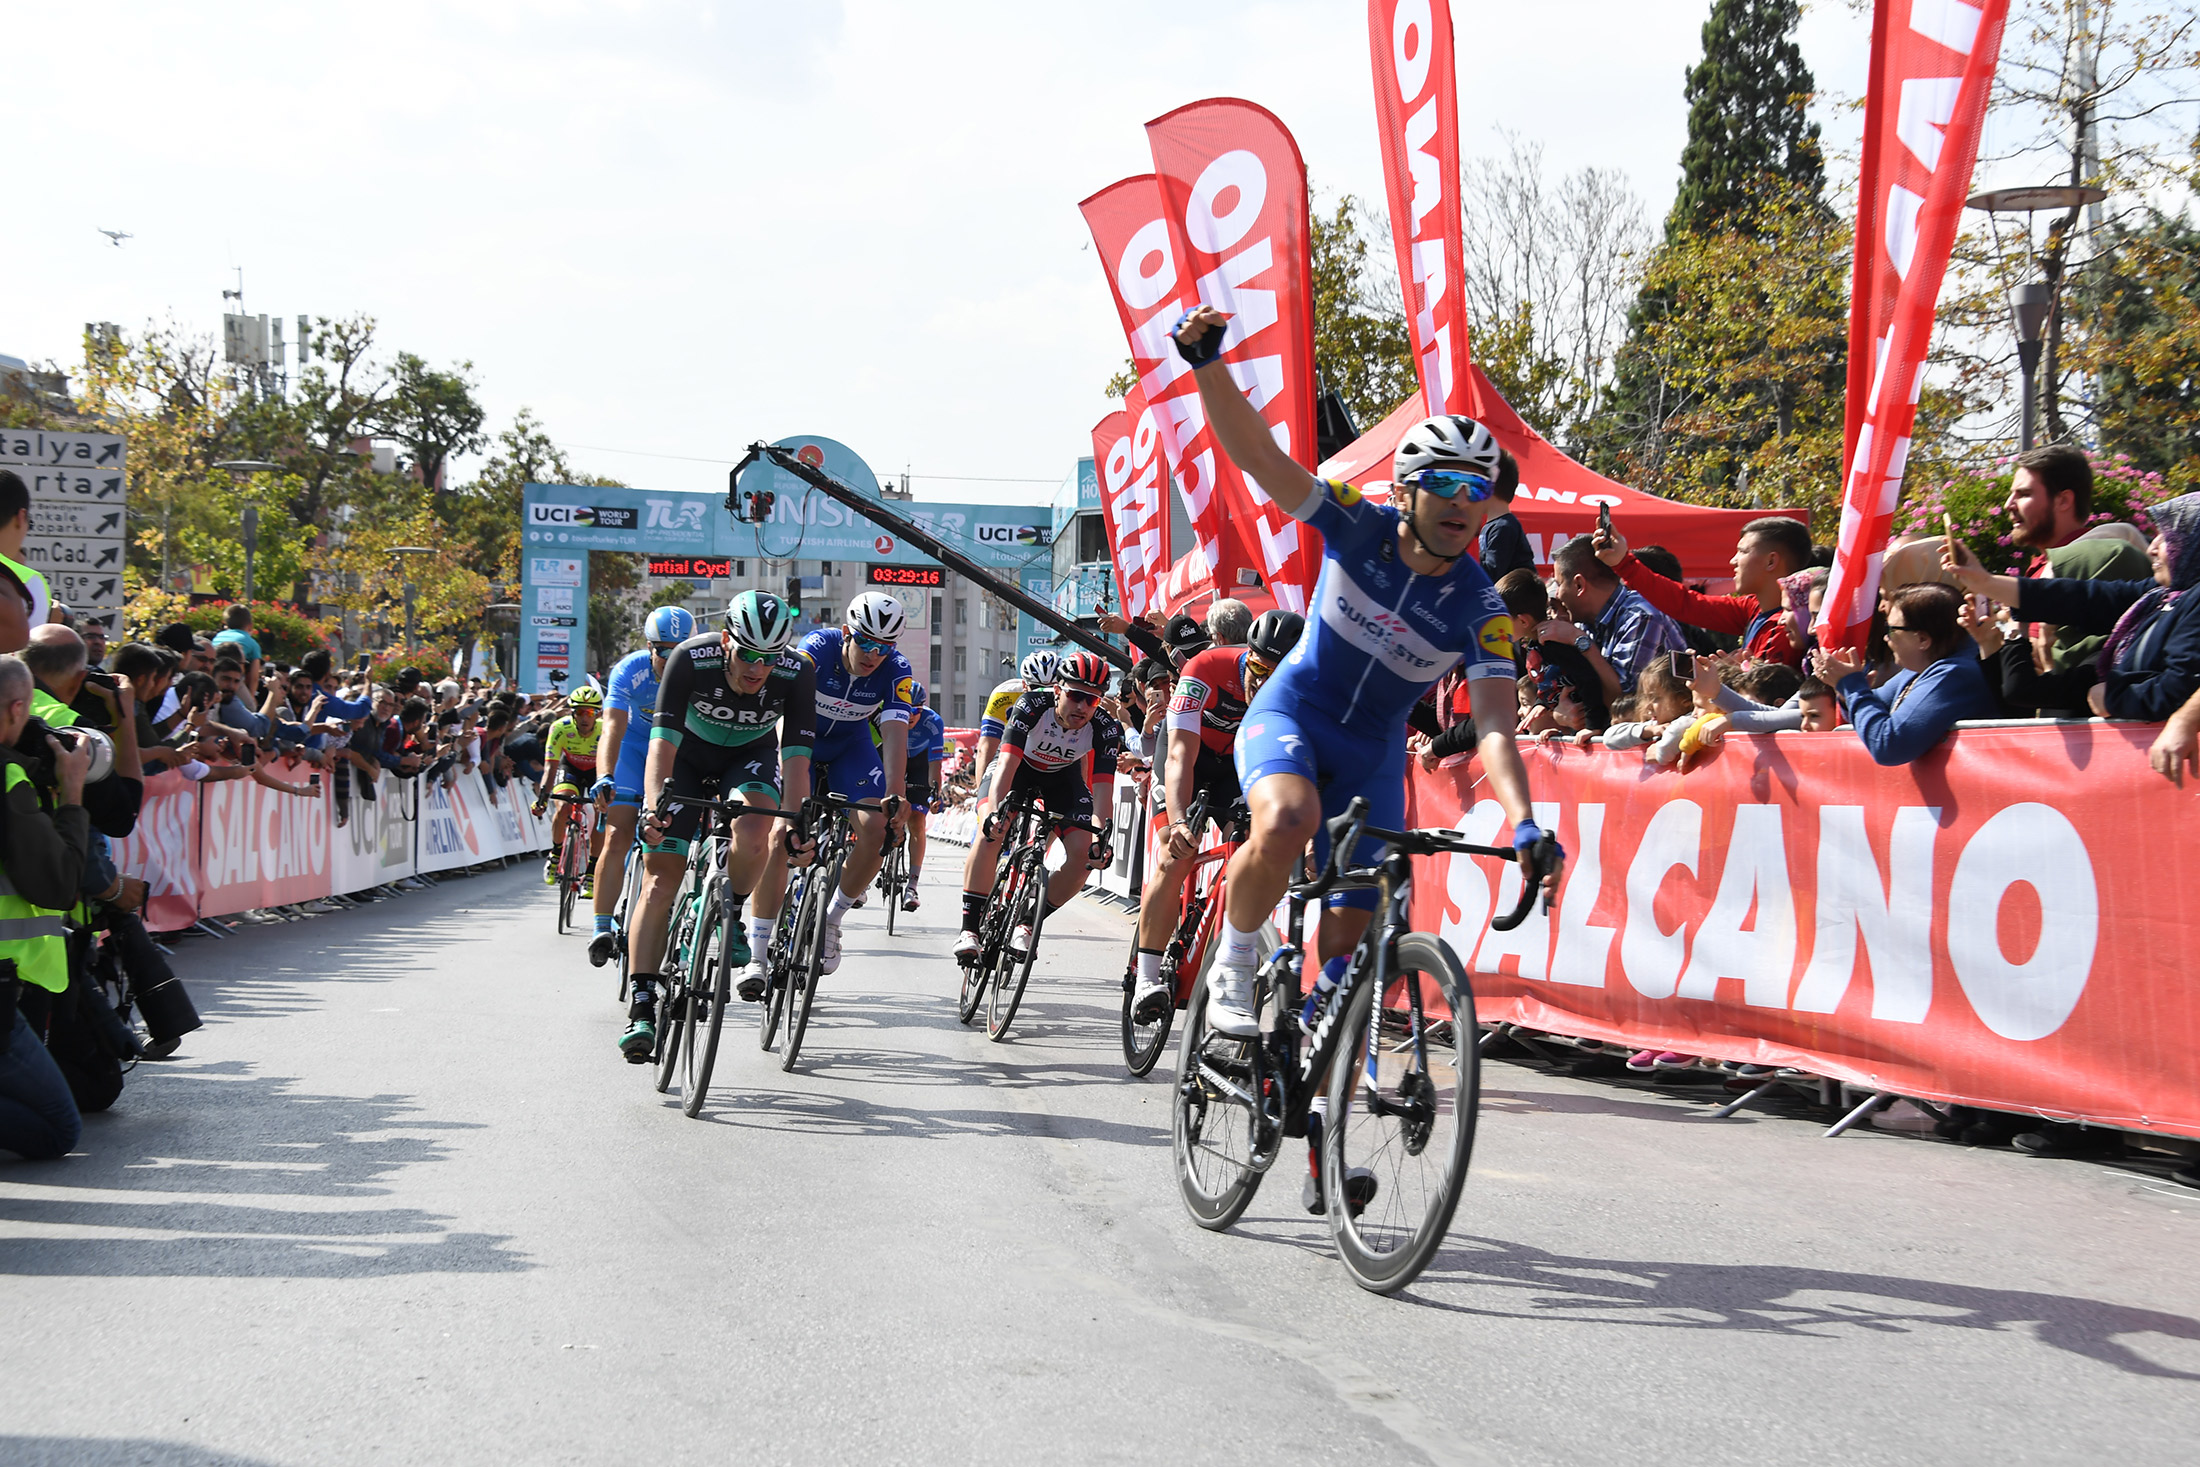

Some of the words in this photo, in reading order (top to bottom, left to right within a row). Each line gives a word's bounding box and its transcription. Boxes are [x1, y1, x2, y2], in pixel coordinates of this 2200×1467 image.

[534, 507, 570, 523] UCI
[599, 510, 631, 519] WORLD
[599, 518, 623, 527] TOUR
[645, 499, 708, 530] TUR
[780, 535, 825, 547] TURKISH
[826, 537, 873, 549] AIRLINES
[978, 527, 1013, 542] UCI
[52, 541, 91, 563] Cad.
[693, 559, 731, 578] Cycl
[873, 568, 940, 585] 03:29:16
[533, 617, 549, 625] UCI
[1029, 637, 1045, 645] UCI
[690, 646, 723, 660] BORA
[631, 668, 650, 690] KTM
[694, 700, 779, 725] BORA
[1037, 741, 1077, 760] UAE
[207, 780, 327, 889] SALCANO
[350, 796, 378, 857] UCI
[1440, 798, 2099, 1041] SALCANO
